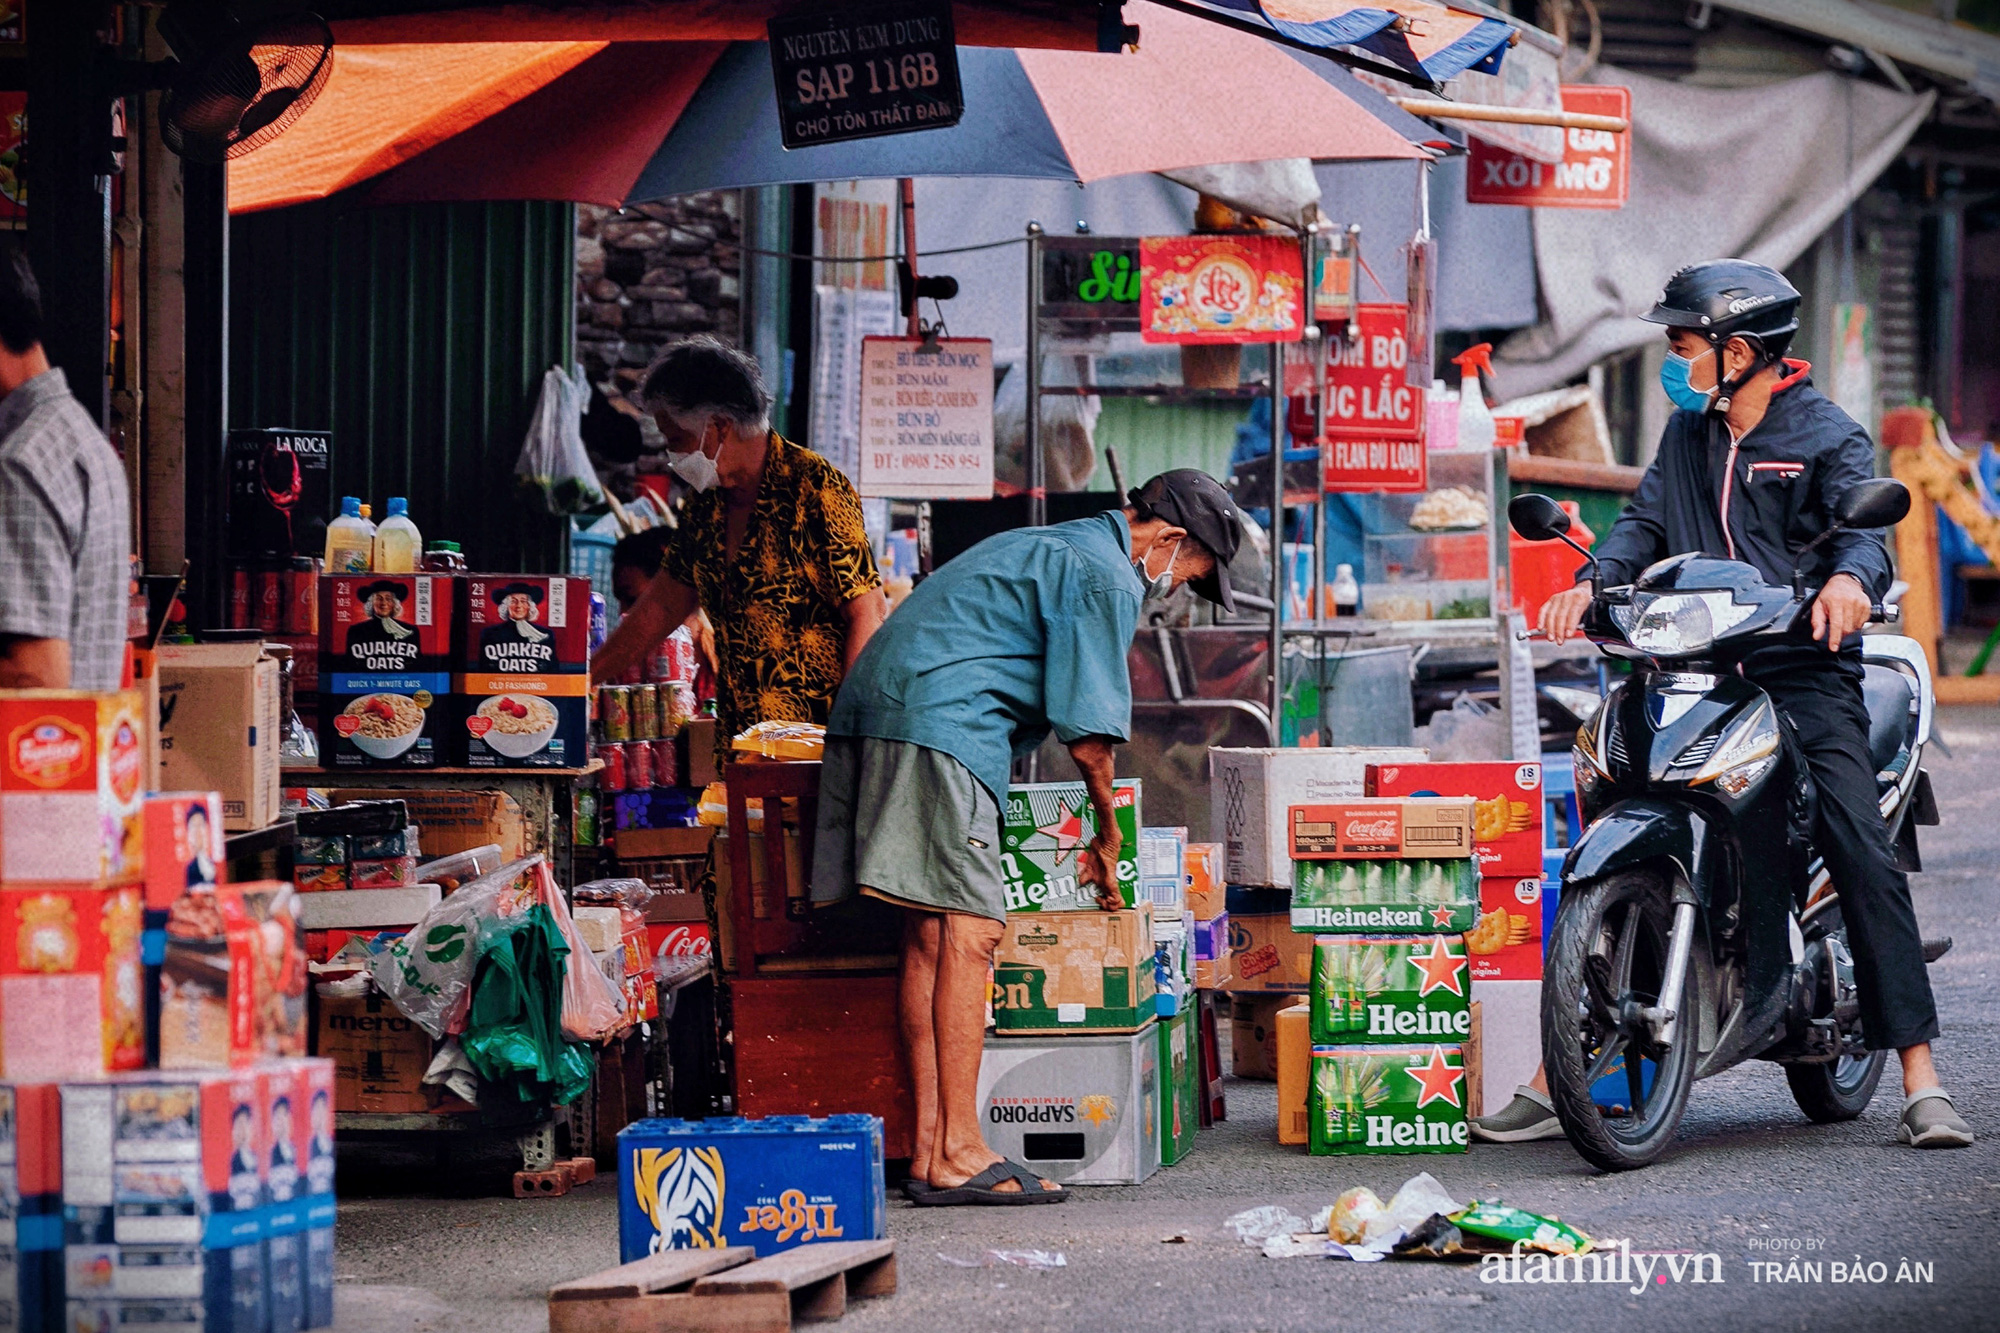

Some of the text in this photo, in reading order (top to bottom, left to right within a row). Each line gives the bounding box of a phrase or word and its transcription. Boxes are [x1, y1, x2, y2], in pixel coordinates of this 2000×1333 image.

[796, 52, 940, 109] SẠP 116B
[795, 116, 830, 136] CHỢ
[832, 111, 867, 132] TÔN
[1483, 154, 1541, 187] XÔI
[1372, 327, 1407, 369] BÒ
[1361, 373, 1411, 422] LẮC
[276, 437, 292, 452] LA
[294, 436, 327, 453] ROCA
[1336, 441, 1368, 469] FLAN
[351, 641, 418, 659] QUAKER
[484, 642, 553, 661] QUAKER
[366, 657, 405, 670] OATS
[499, 658, 538, 672] OATS
[347, 680, 368, 688] QUICK
[404, 680, 421, 688] OATS
[488, 681, 548, 691] OLD FASHIONED
[1521, 767, 1534, 778] 18
[1006, 798, 1023, 813] 20
[1345, 819, 1396, 838] Coca-Cola
[1521, 881, 1534, 892] 18
[1314, 907, 1424, 927] Heineken
[990, 1105, 1075, 1123] SAPPORO
[739, 1189, 844, 1243] Tiger
